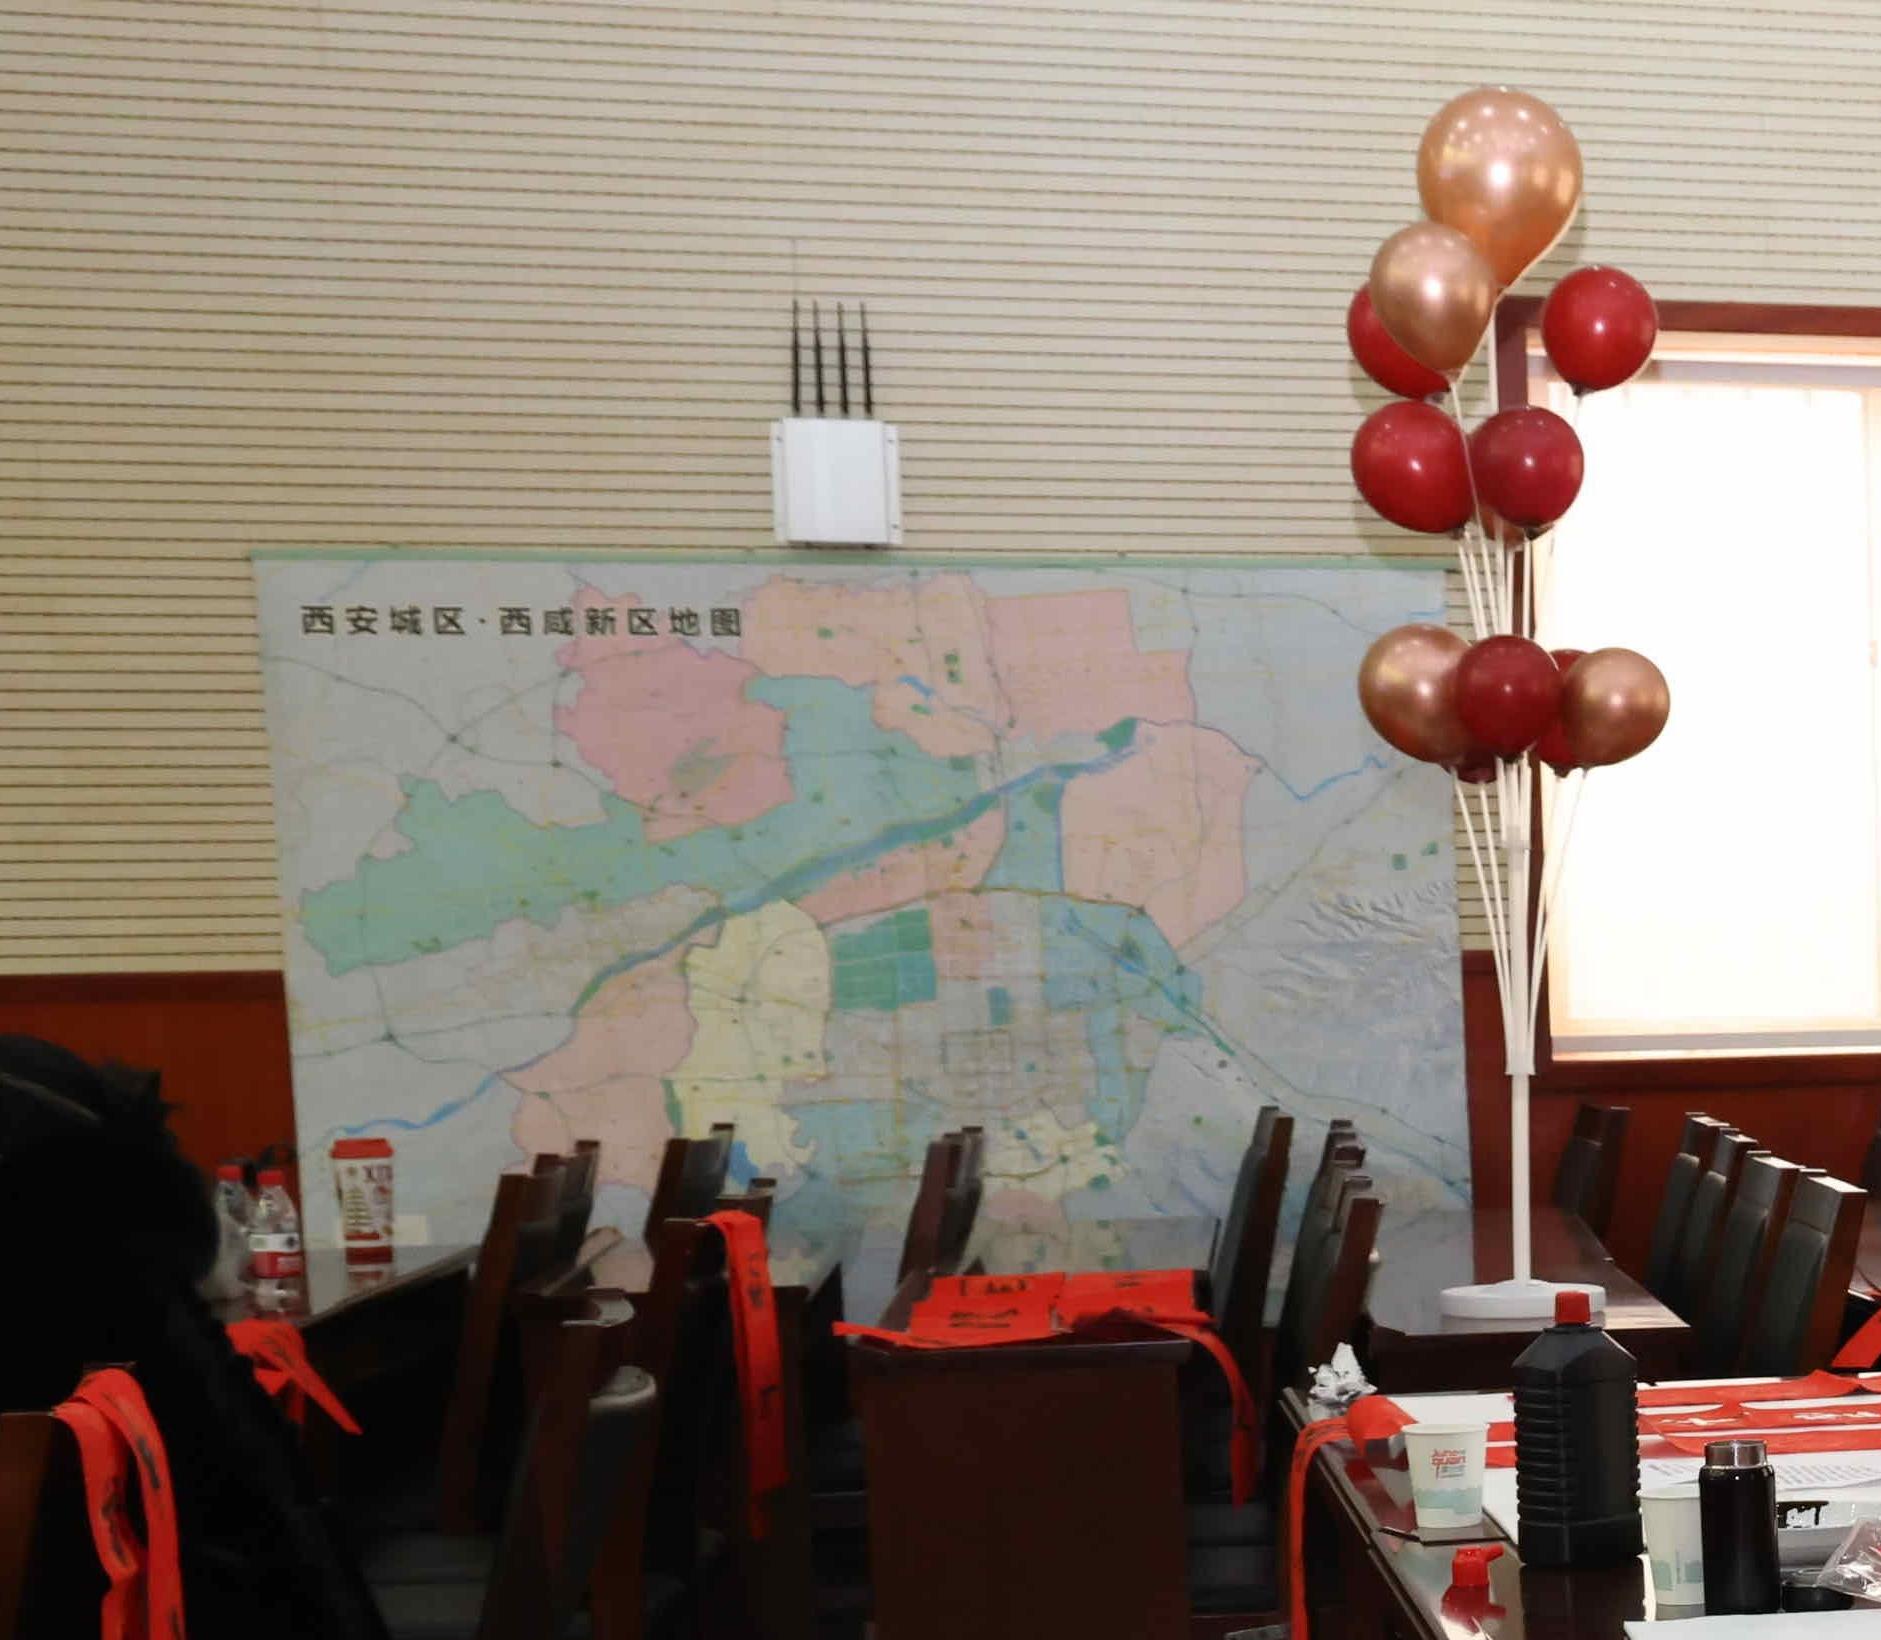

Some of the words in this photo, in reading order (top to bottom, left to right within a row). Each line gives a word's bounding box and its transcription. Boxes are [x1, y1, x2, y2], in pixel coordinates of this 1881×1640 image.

[300, 605, 743, 637] 西安城区·西咸新区地图
